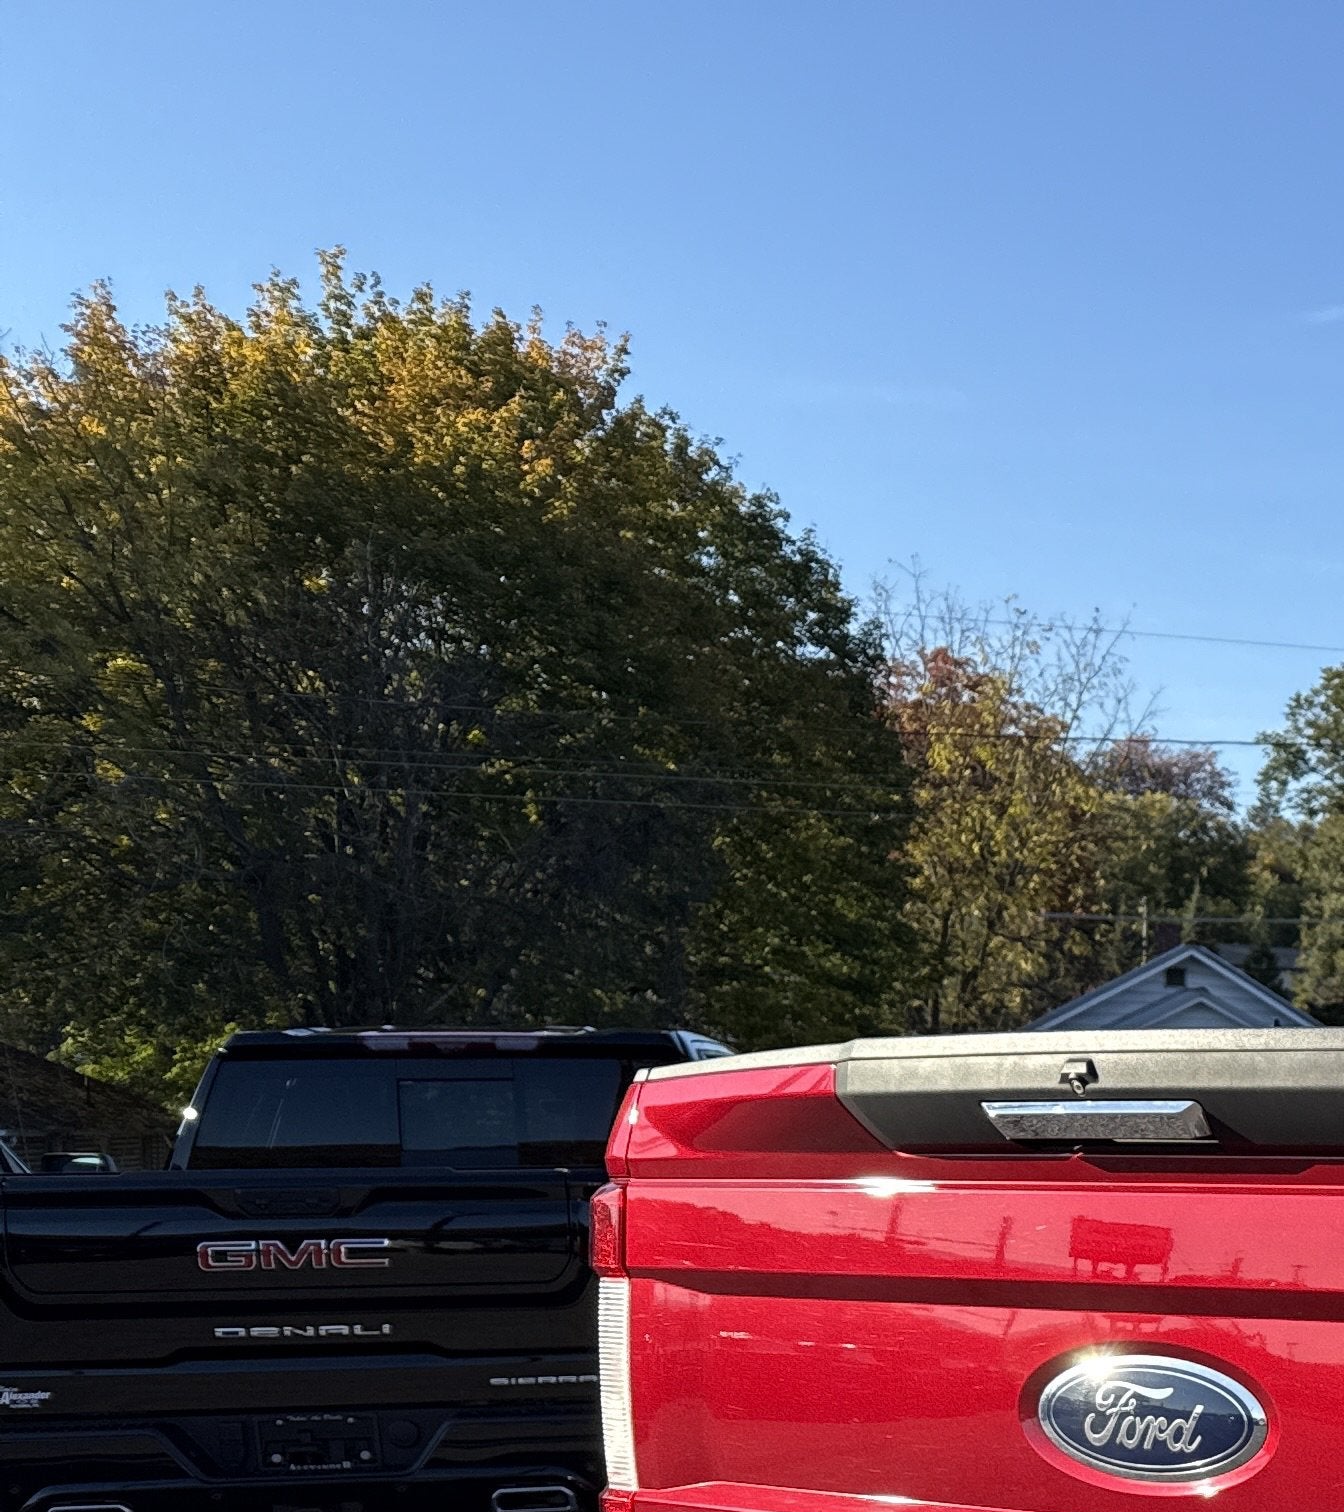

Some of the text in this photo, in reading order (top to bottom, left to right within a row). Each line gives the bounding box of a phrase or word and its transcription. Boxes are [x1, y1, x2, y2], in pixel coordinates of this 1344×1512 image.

[197, 1238, 389, 1271] GMC
[214, 1324, 391, 1337] DENALI
[489, 1374, 599, 1386] SIERRA
[1084, 1379, 1205, 1453] Ford
